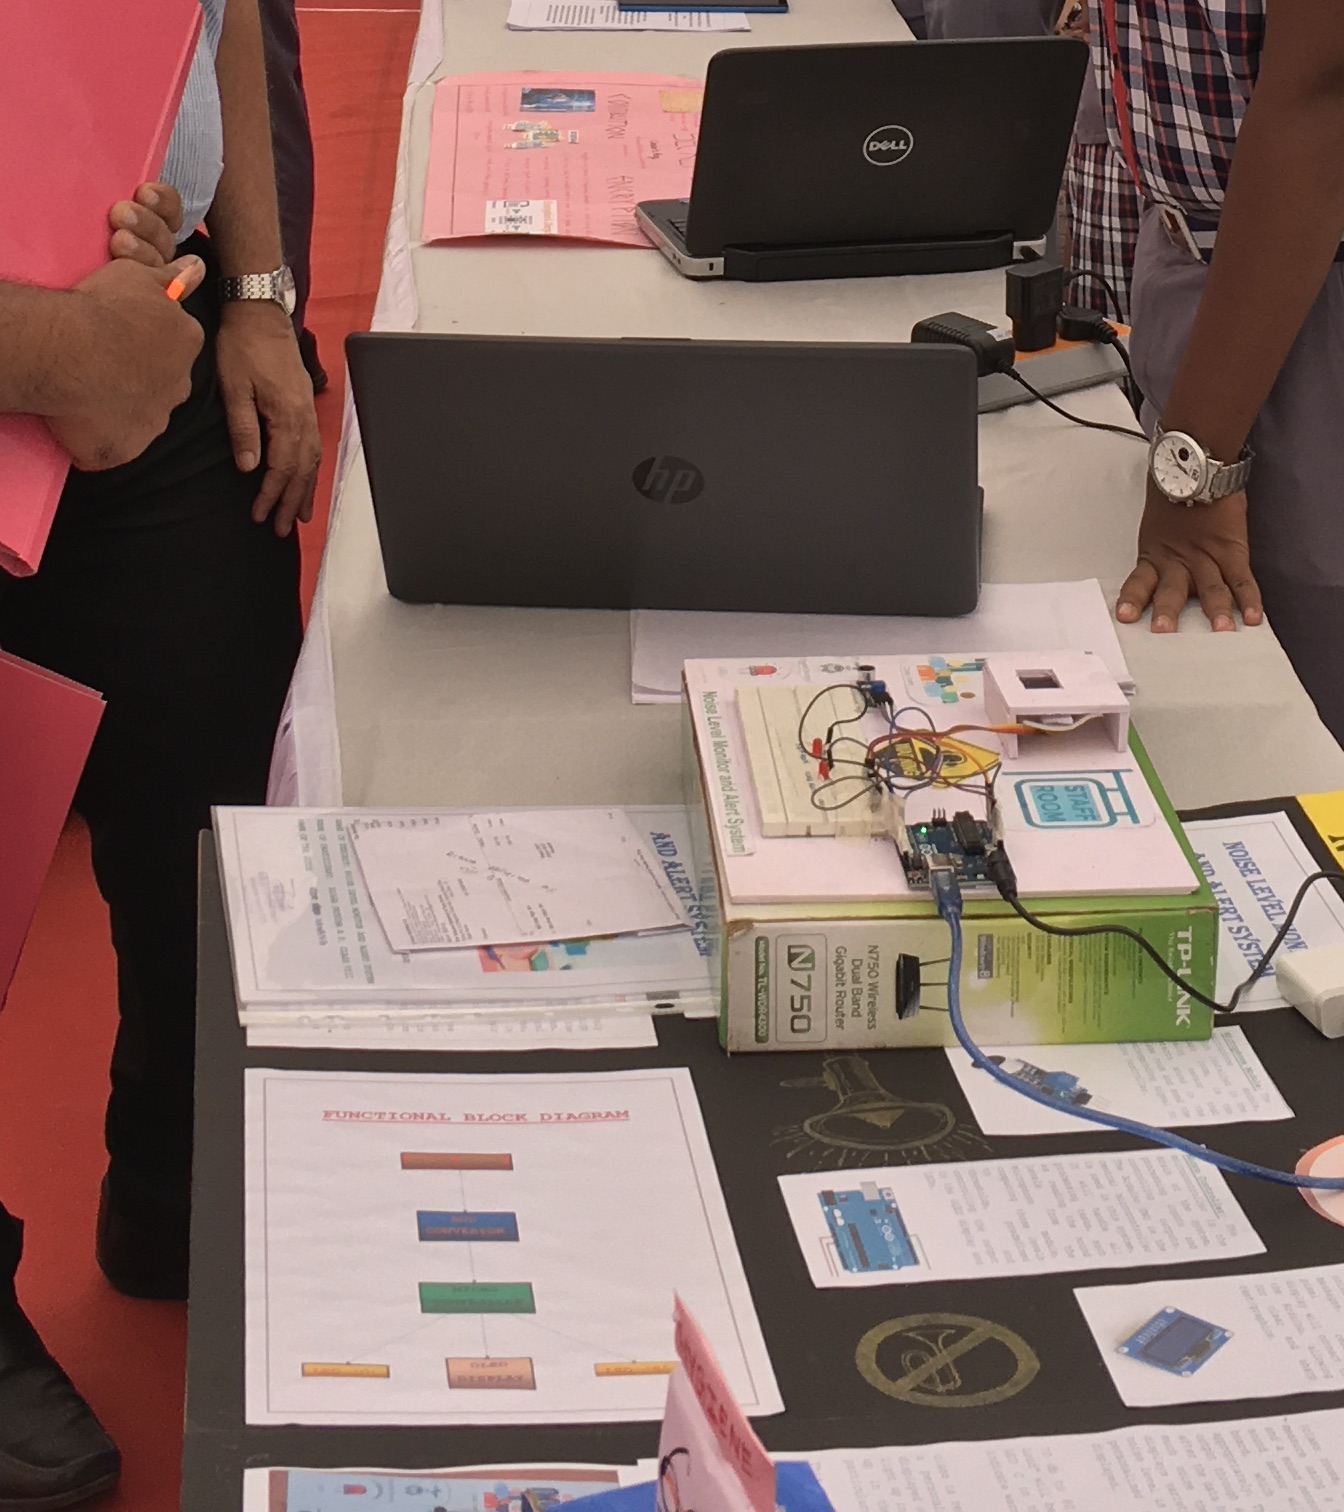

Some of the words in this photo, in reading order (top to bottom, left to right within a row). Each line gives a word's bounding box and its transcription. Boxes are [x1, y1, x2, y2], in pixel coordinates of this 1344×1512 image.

[867, 138, 908, 153] DELL
[703, 690, 723, 714] Noise
[708, 715, 727, 740] Level
[712, 740, 732, 773] Monitor
[720, 774, 737, 792] and
[722, 792, 741, 816] Alert
[1037, 785, 1067, 823] ROOM
[1064, 785, 1096, 821] STAFF
[651, 831, 677, 858] AND
[724, 817, 748, 854] System
[662, 858, 696, 903] ALERT
[1222, 841, 1263, 878] NOISE
[1246, 878, 1286, 921] LEVEL
[833, 945, 848, 987] Gigabit
[867, 944, 880, 986] N750
[1227, 925, 1277, 979] SYSTEM
[787, 944, 816, 1035] N750
[851, 958, 864, 987] Dual
[1174, 926, 1193, 1026] TP-LNK
[756, 976, 768, 1037] TL-WDR4300
[834, 989, 848, 1031] Router
[851, 988, 864, 1018] Band
[867, 987, 880, 1032] Wireless
[322, 1109, 452, 1122] FUNCTIONAL
[463, 1110, 527, 1122] BLOCK
[540, 1109, 631, 1122] DIAGRAM
[458, 1373, 525, 1384] DISPLAY
